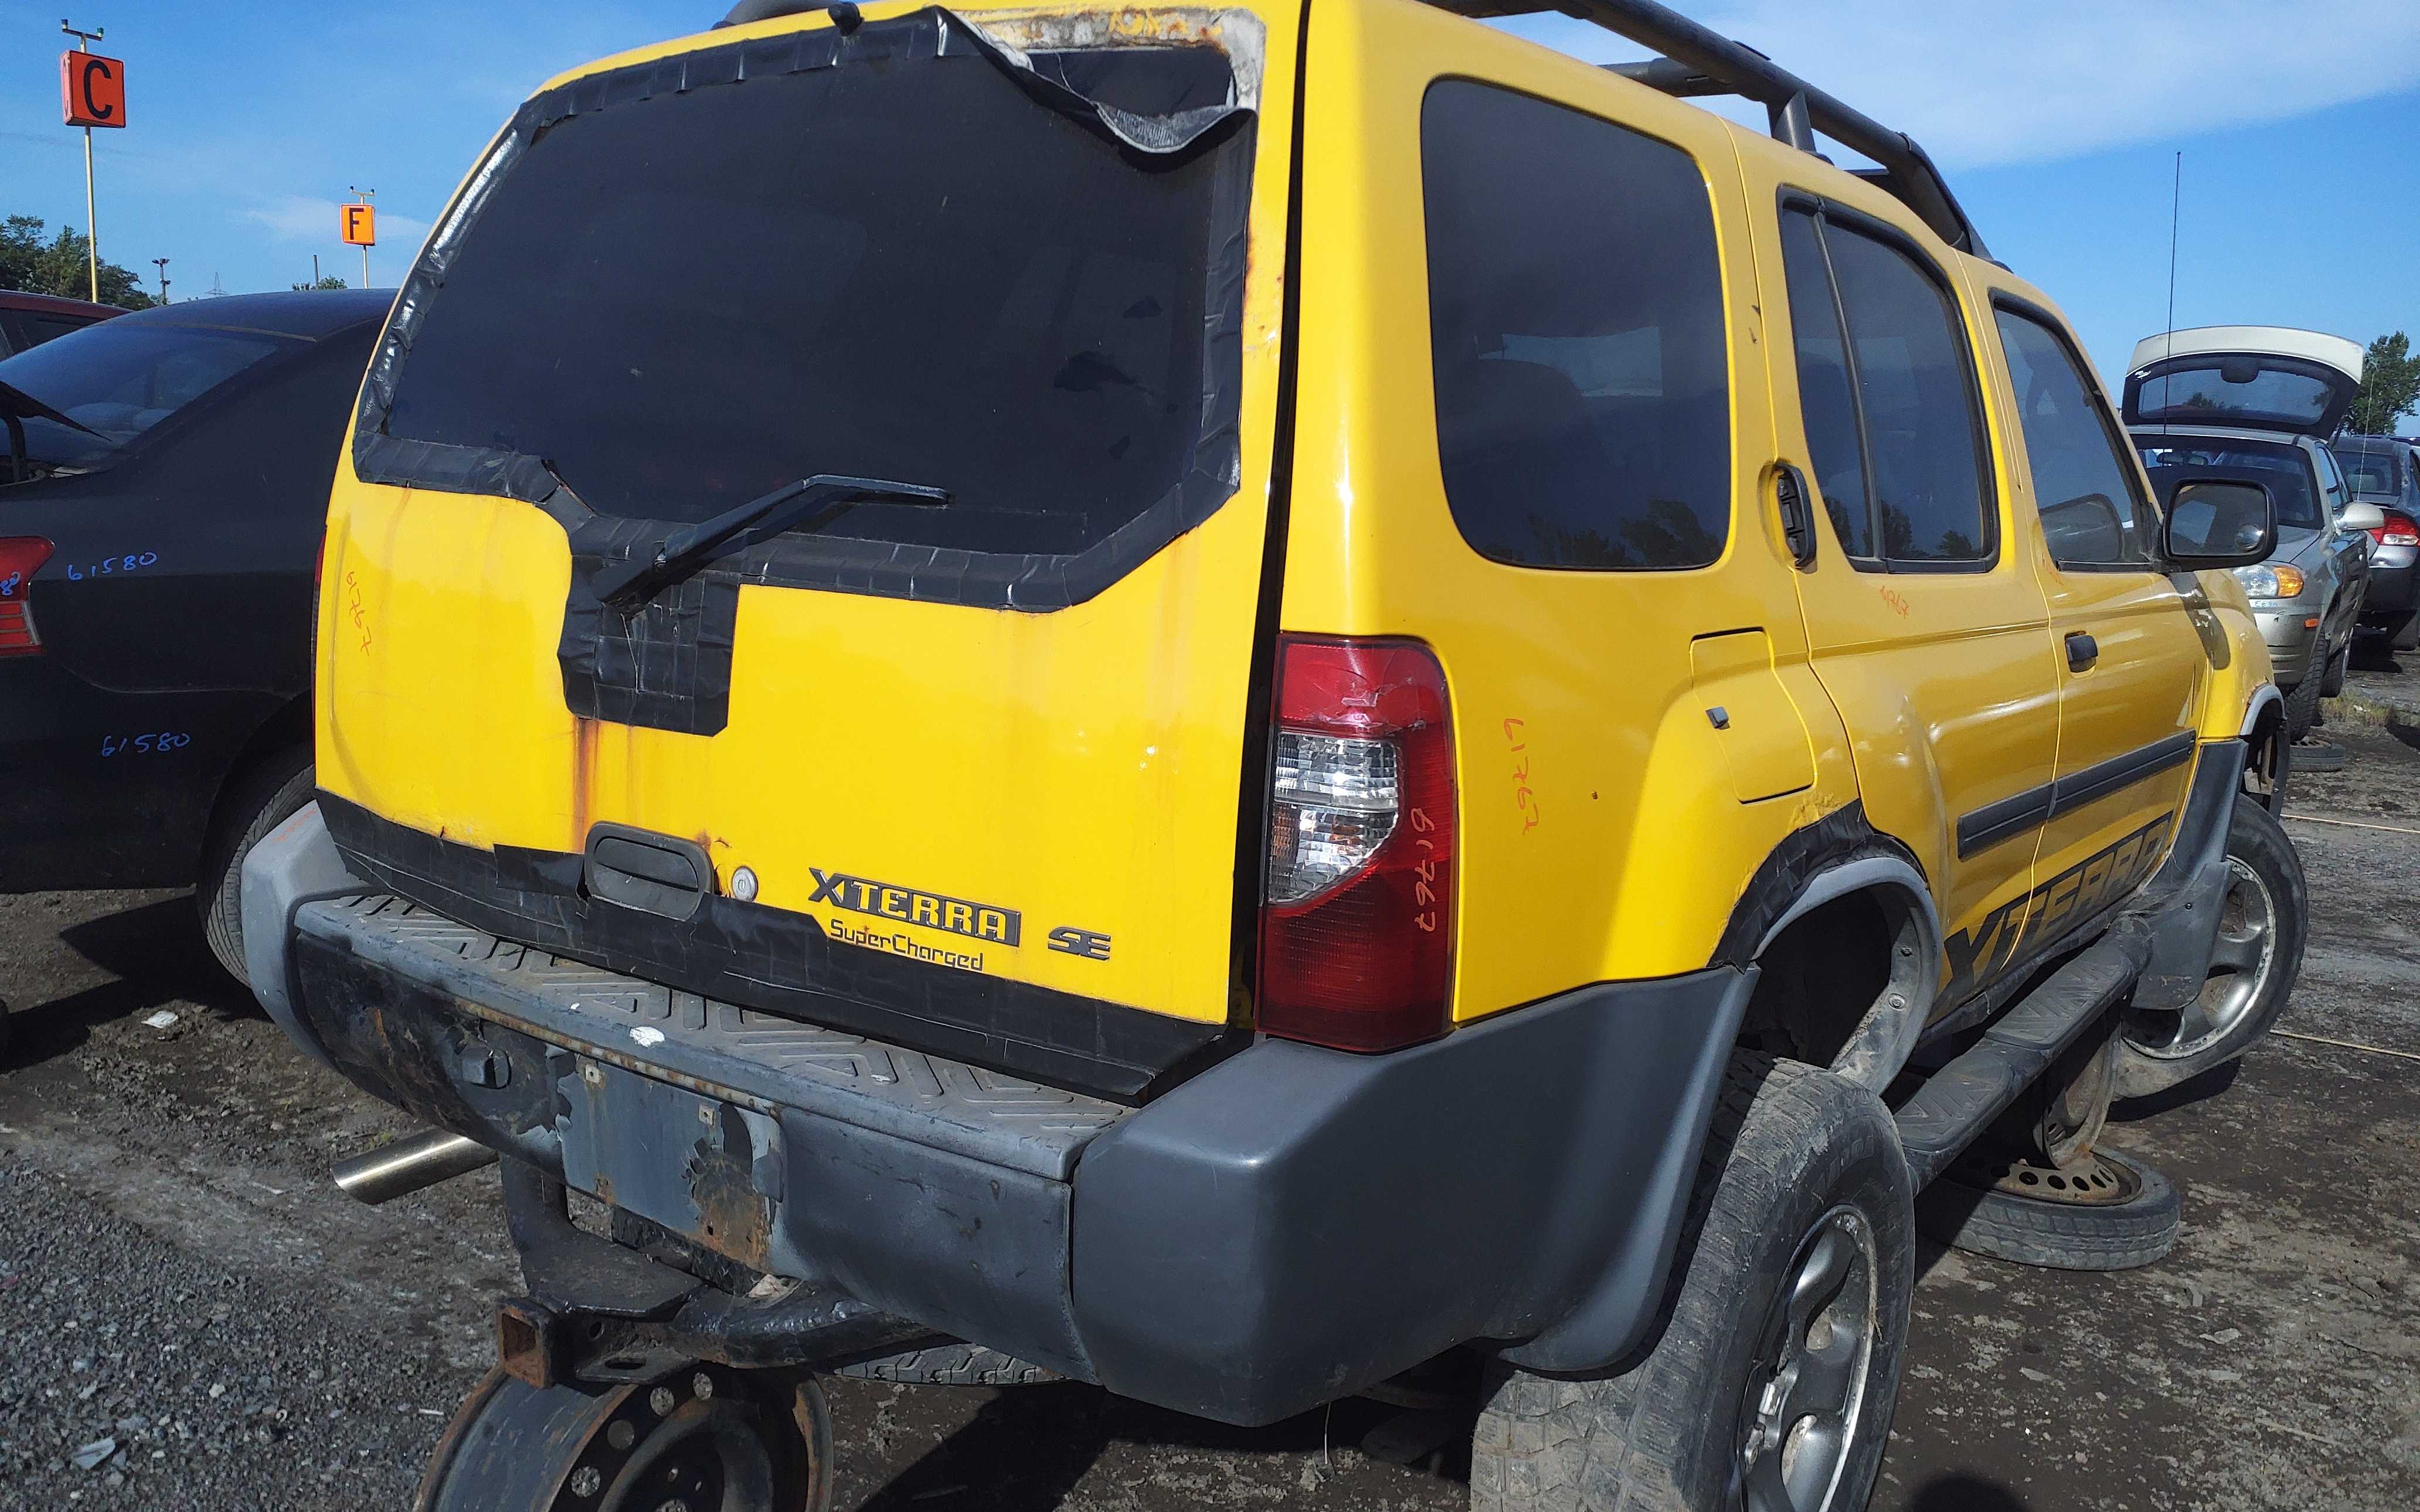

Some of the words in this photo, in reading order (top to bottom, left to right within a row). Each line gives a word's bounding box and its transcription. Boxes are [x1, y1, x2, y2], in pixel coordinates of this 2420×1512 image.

[83, 59, 113, 120] C
[349, 207, 364, 240] F
[67, 552, 157, 581] 61580
[346, 571, 372, 656] 61767
[101, 732, 190, 757] 61580
[1410, 808, 1436, 932] 61767
[808, 867, 1021, 947] XTERRA
[1047, 927, 1111, 961] SE
[830, 918, 983, 971] SuperCharged
